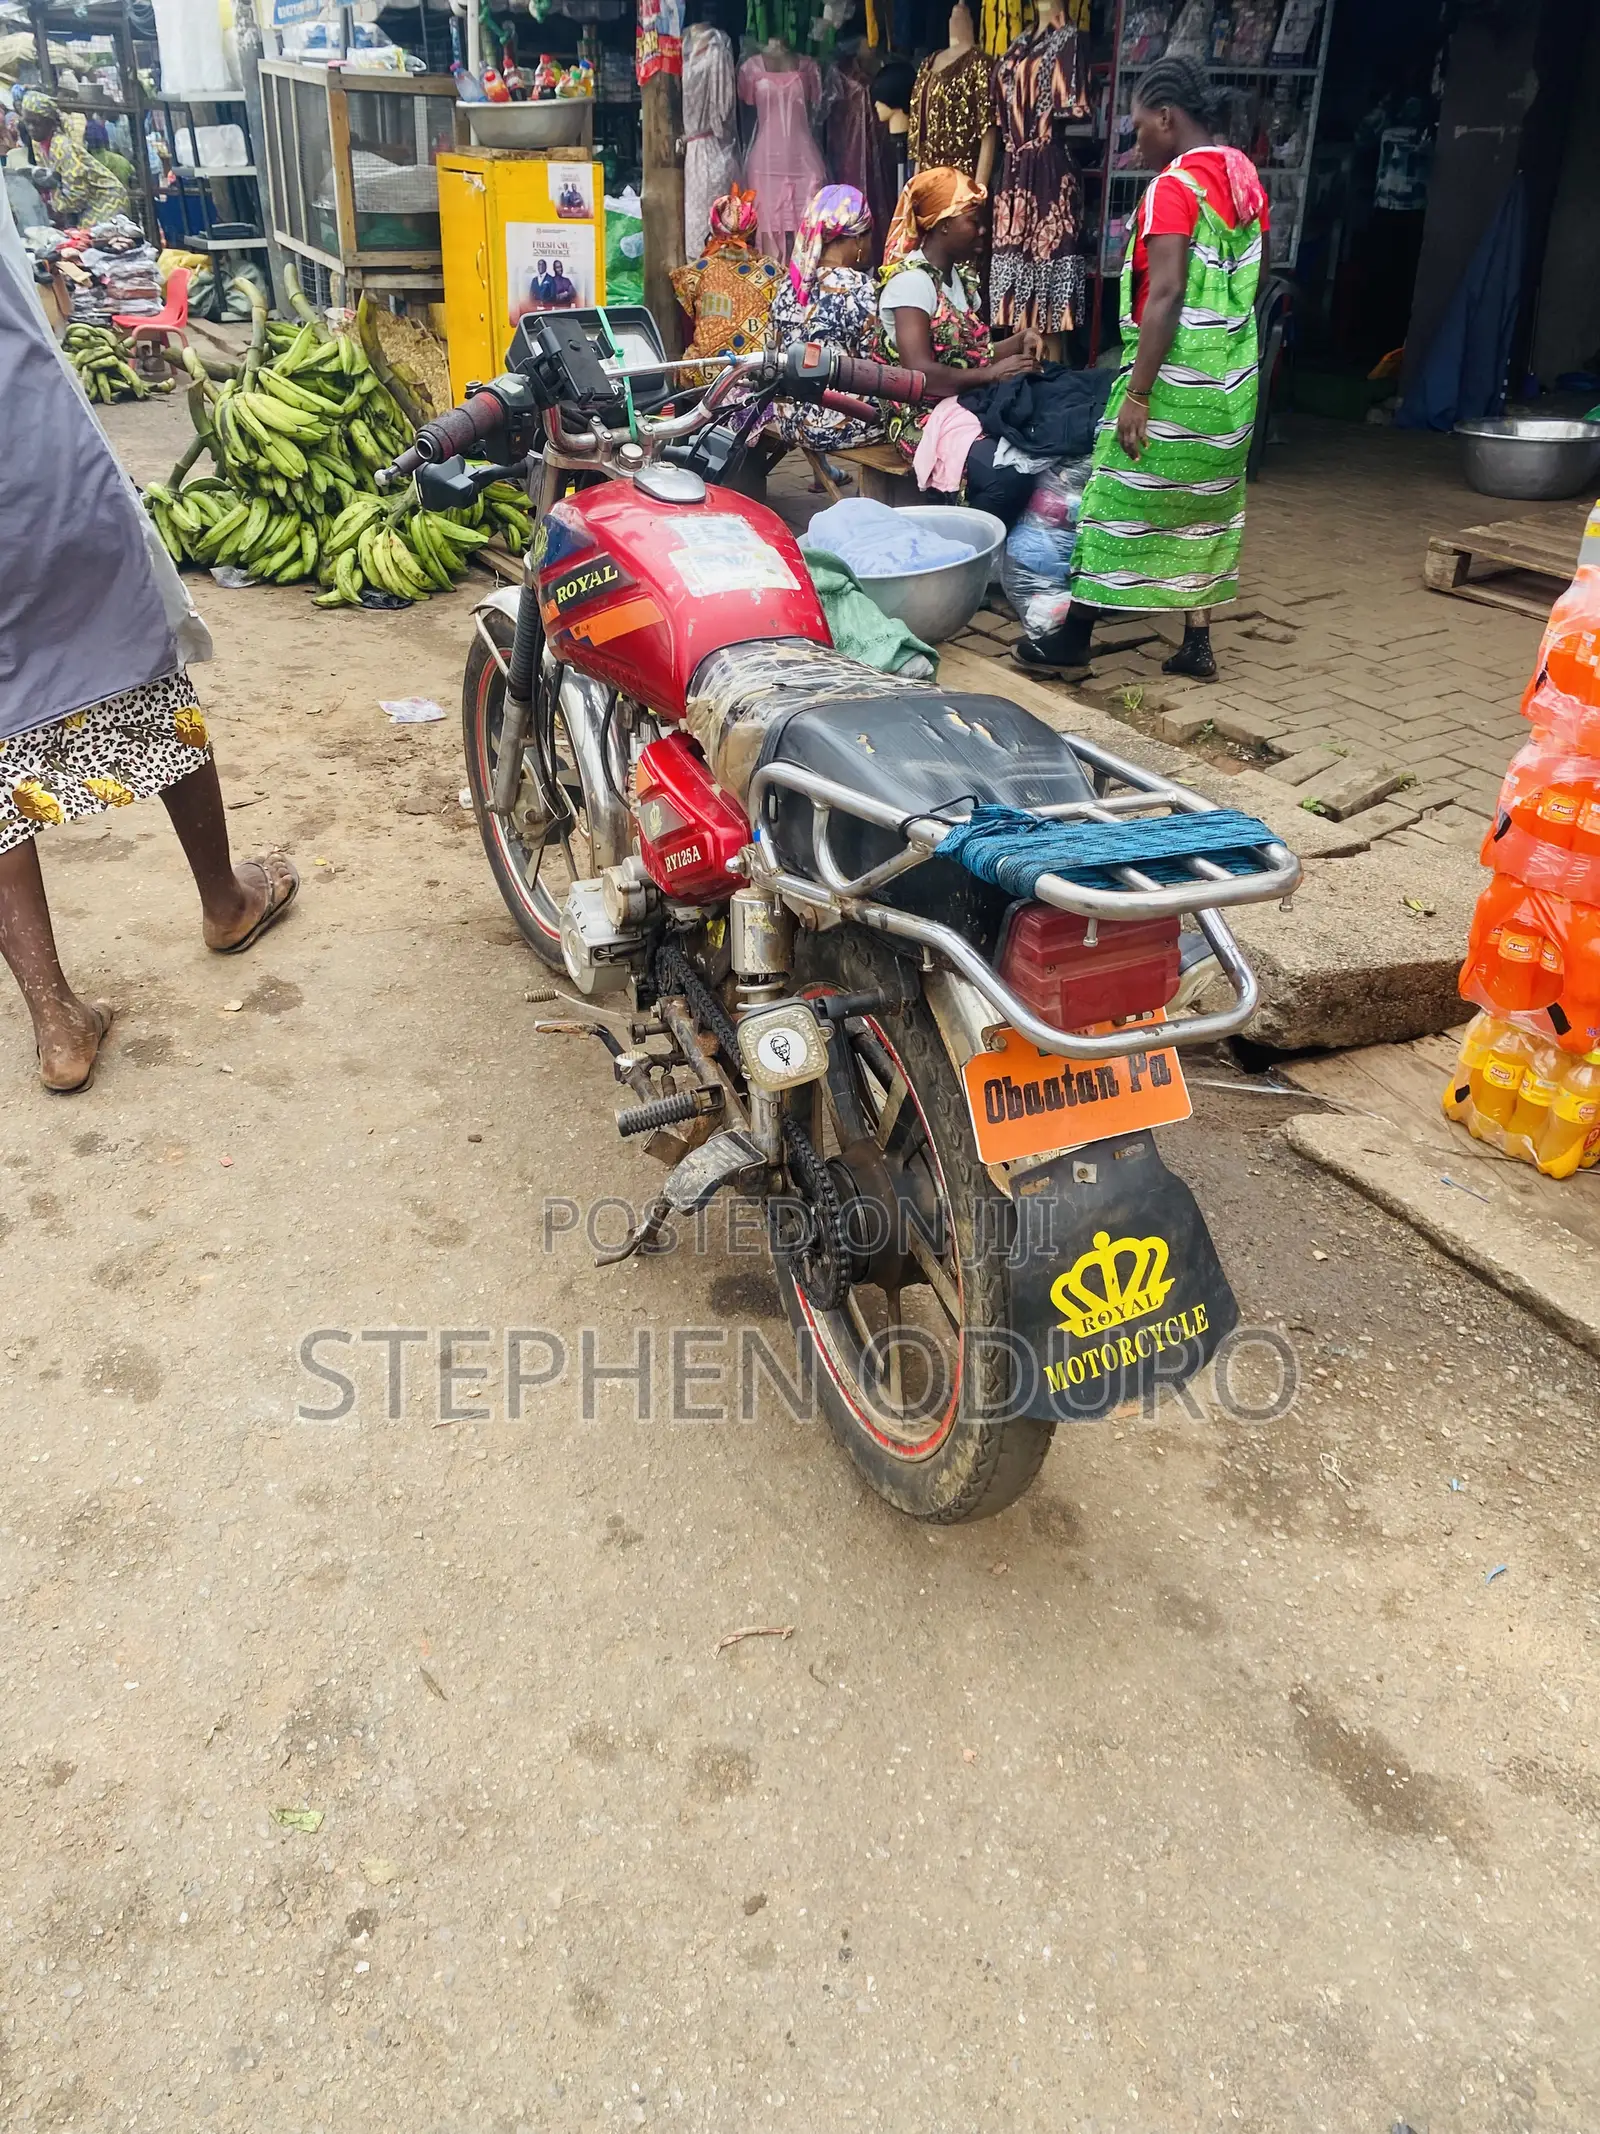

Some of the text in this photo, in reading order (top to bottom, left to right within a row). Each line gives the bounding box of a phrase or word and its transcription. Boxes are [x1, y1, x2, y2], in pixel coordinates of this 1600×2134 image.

[532, 241, 555, 249] FRESH
[748, 318, 759, 333] B
[556, 565, 618, 605] ROYAL
[1551, 803, 1575, 815] PLANET
[664, 845, 702, 873] RY125A
[1507, 942, 1530, 954] PLANET
[984, 1053, 1172, 1124] Obaatan Pa
[1080, 1293, 1159, 1334] ROYAL
[1043, 1303, 1210, 1395] MOTORCYCLE
